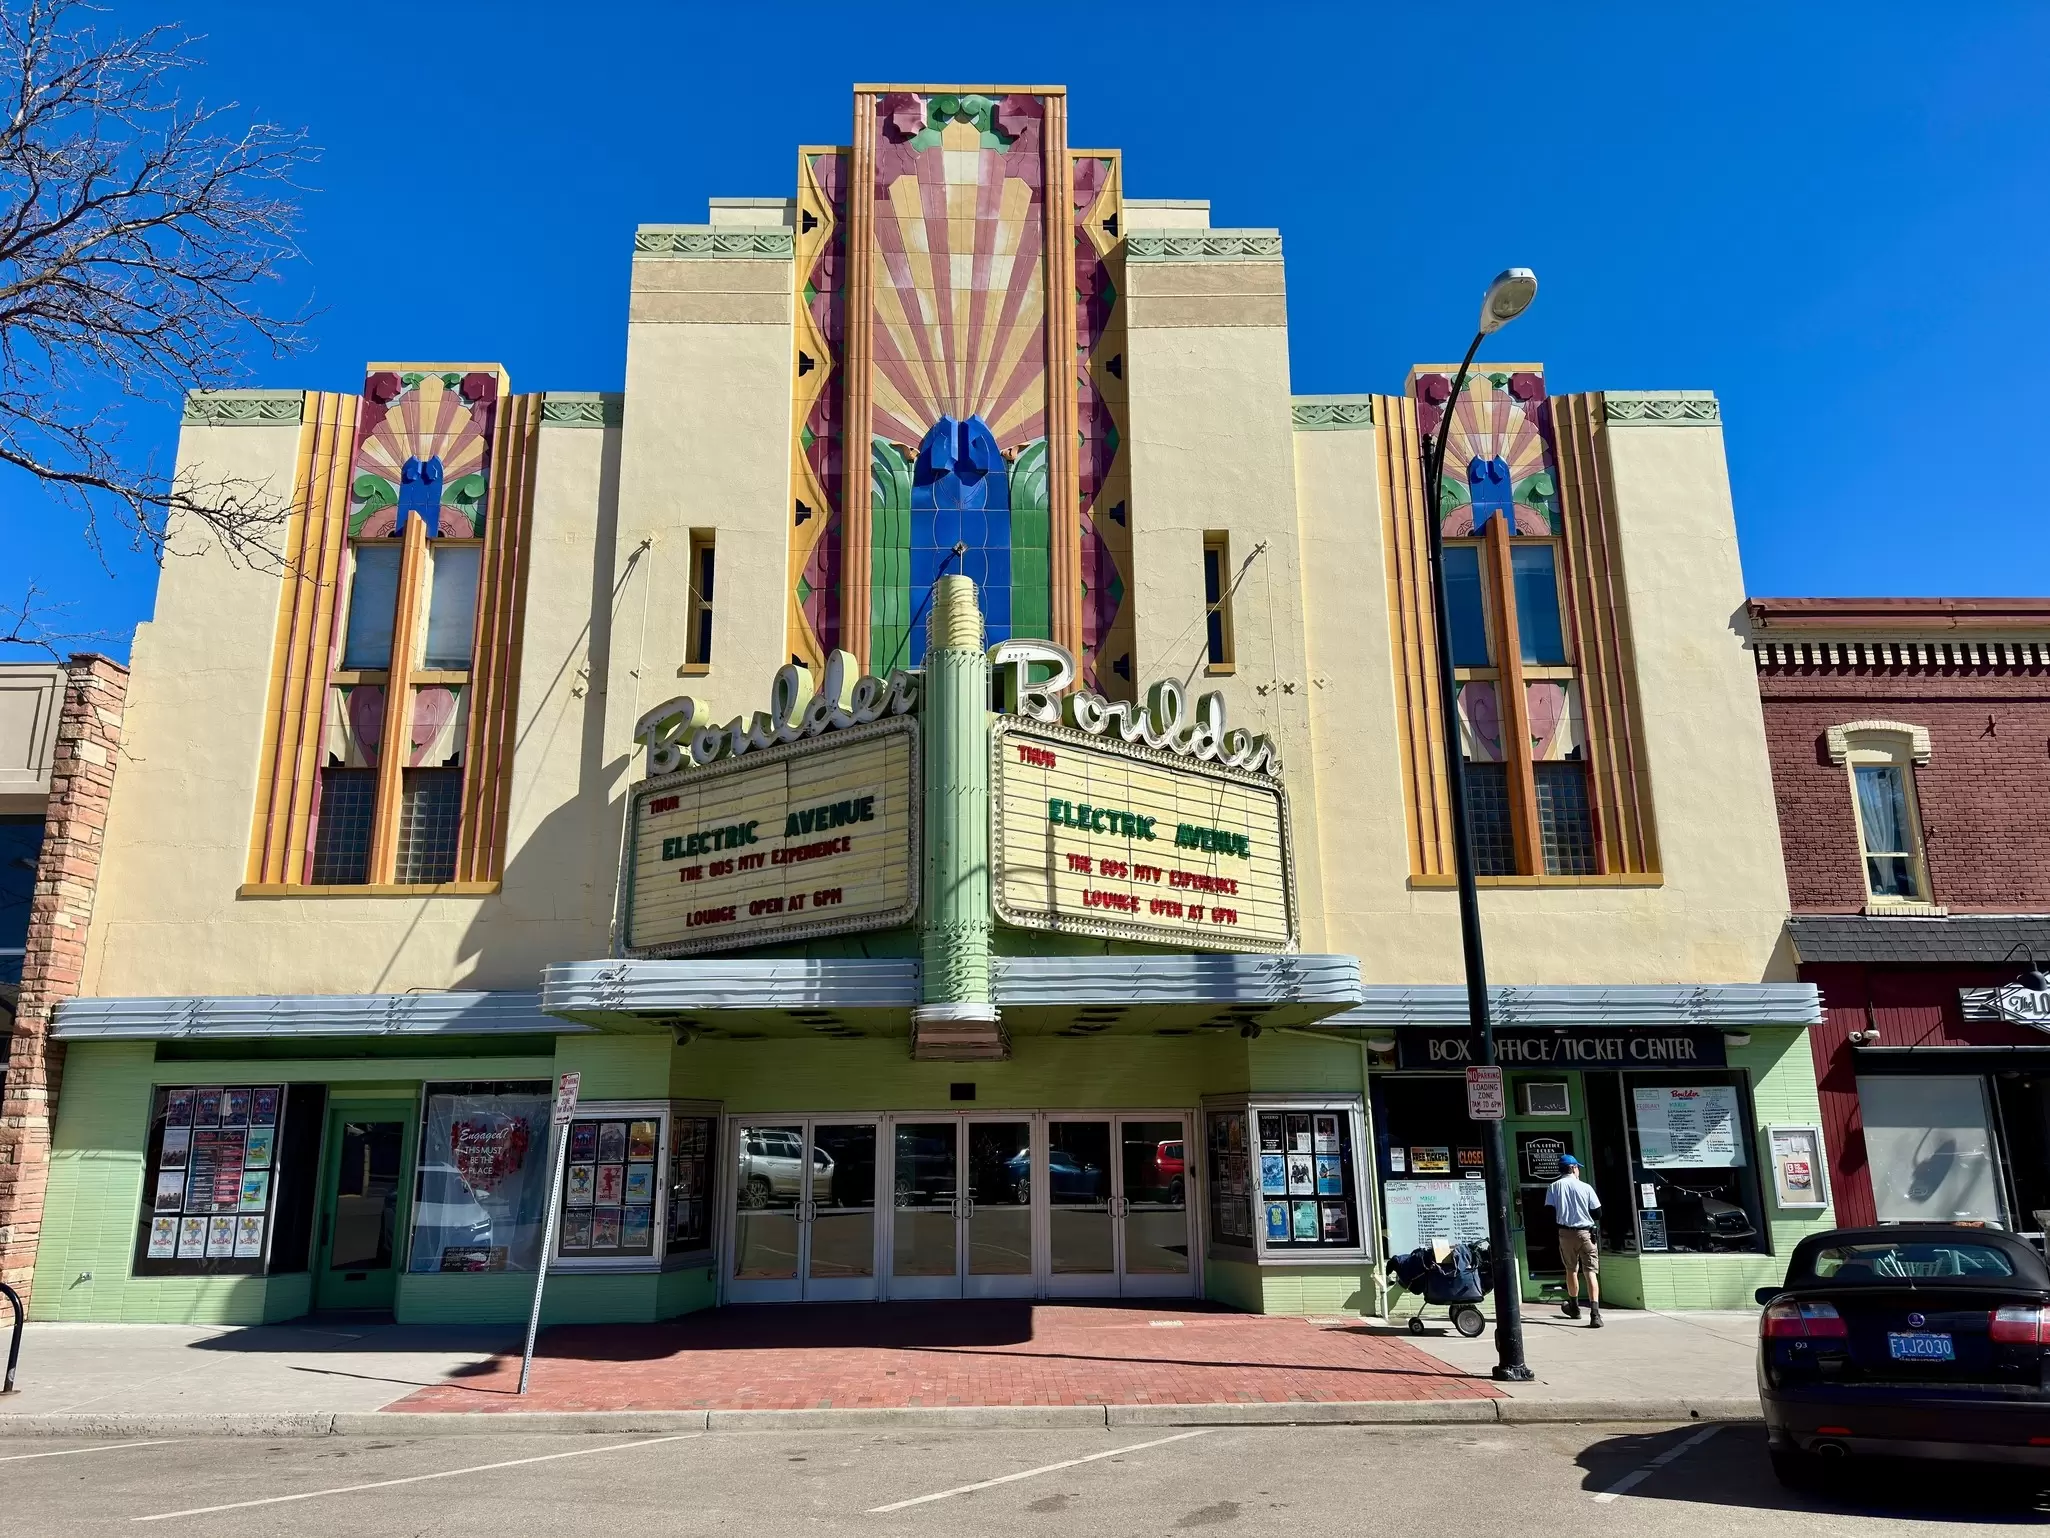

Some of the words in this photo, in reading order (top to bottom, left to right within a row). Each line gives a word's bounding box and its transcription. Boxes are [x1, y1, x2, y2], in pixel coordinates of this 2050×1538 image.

[634, 649, 920, 776] Boulder
[988, 638, 1284, 776] Boulder
[1017, 744, 1056, 769] THUR
[649, 796, 680, 814] THUR
[662, 820, 759, 861] ELECTRIC
[784, 796, 874, 837] AVENUE
[1049, 798, 1157, 841] ELECTRIC
[1174, 823, 1250, 860] AVENUE
[679, 865, 703, 882] THE
[709, 858, 733, 877] 80S
[738, 852, 765, 871] MTV
[771, 836, 851, 865] EXPERIENCE
[1066, 852, 1092, 874] THE
[1133, 863, 1162, 884] MTV
[1168, 869, 1239, 895] EXPERIENCE
[686, 905, 737, 927] LOUNGE
[749, 896, 783, 916] OPEN
[788, 894, 806, 911] AT
[813, 888, 842, 907] 6PM
[1082, 889, 1141, 913] LOUNGE
[1149, 898, 1183, 919] OPEN
[1187, 904, 1205, 921] AT
[1211, 906, 1238, 925] 6PM
[2008, 996, 2033, 1014] The
[1428, 1039, 1472, 1061] BOX
[1630, 1038, 1697, 1059] CENTER
[1467, 1070, 1478, 1082] NO
[1477, 1072, 1500, 1081] PARKING
[1491, 1100, 1501, 1108] 6PM
[1670, 1089, 1699, 1098] Boulder
[460, 1128, 509, 1143] Engaged?
[481, 1146, 502, 1154] MUST
[1412, 1153, 1425, 1162] FREE
[1426, 1152, 1448, 1161] TICKETS
[1889, 1338, 1951, 1354] F1J2030
